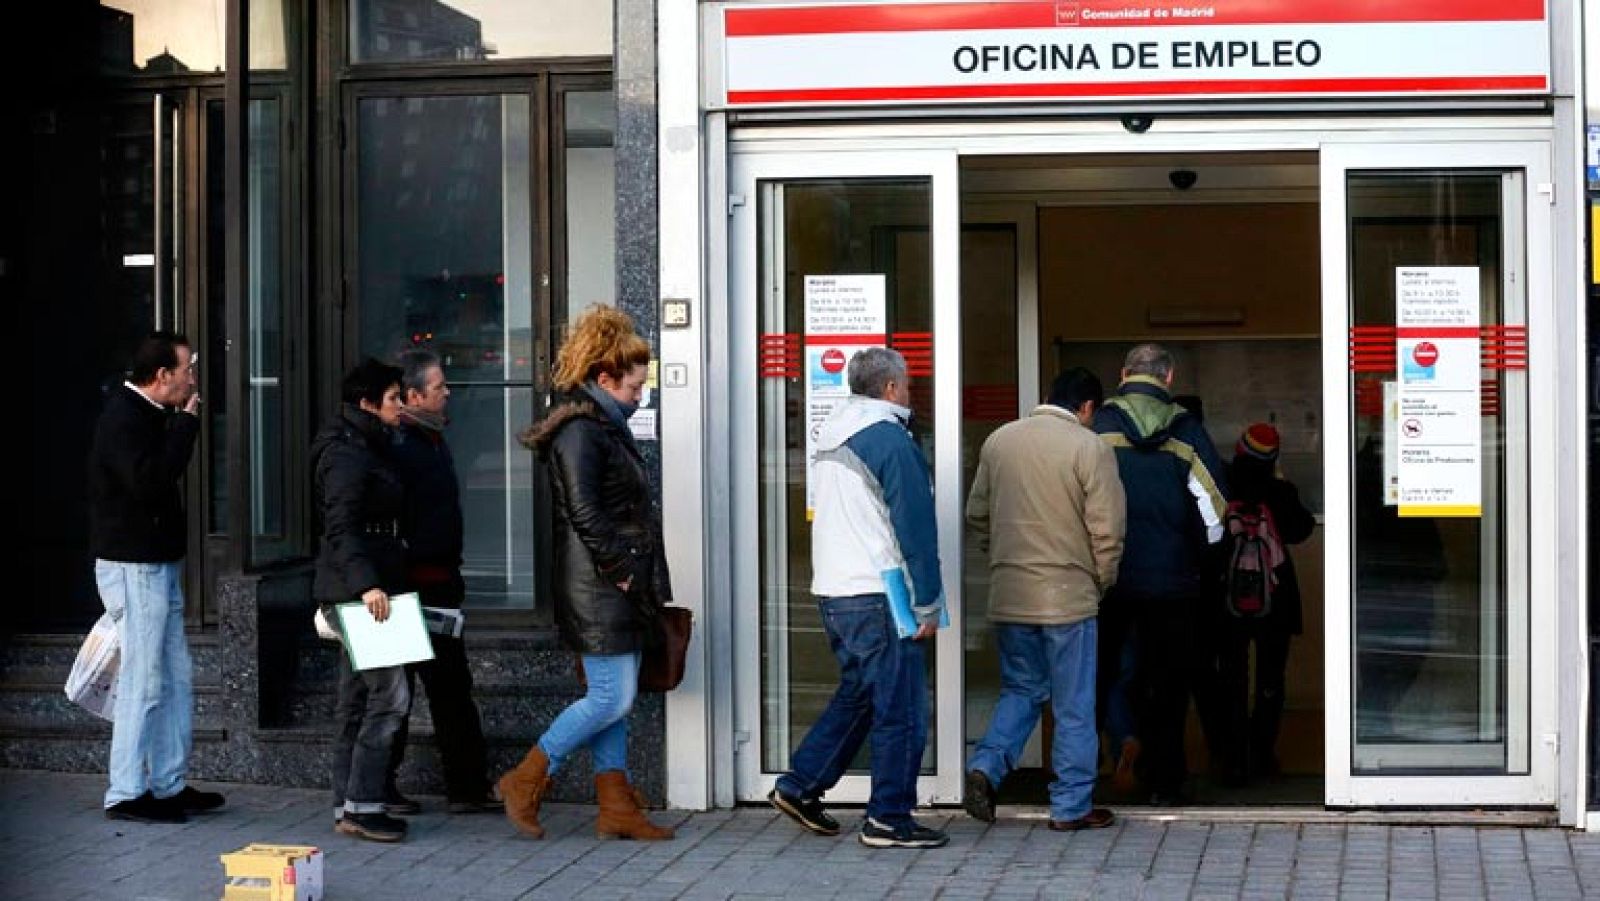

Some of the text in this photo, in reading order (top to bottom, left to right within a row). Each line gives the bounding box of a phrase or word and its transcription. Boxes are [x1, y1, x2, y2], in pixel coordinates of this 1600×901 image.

[1081, 7, 1215, 20] Comunidad de Madrid
[953, 39, 1322, 74] OFICINA DE EMPLEO
